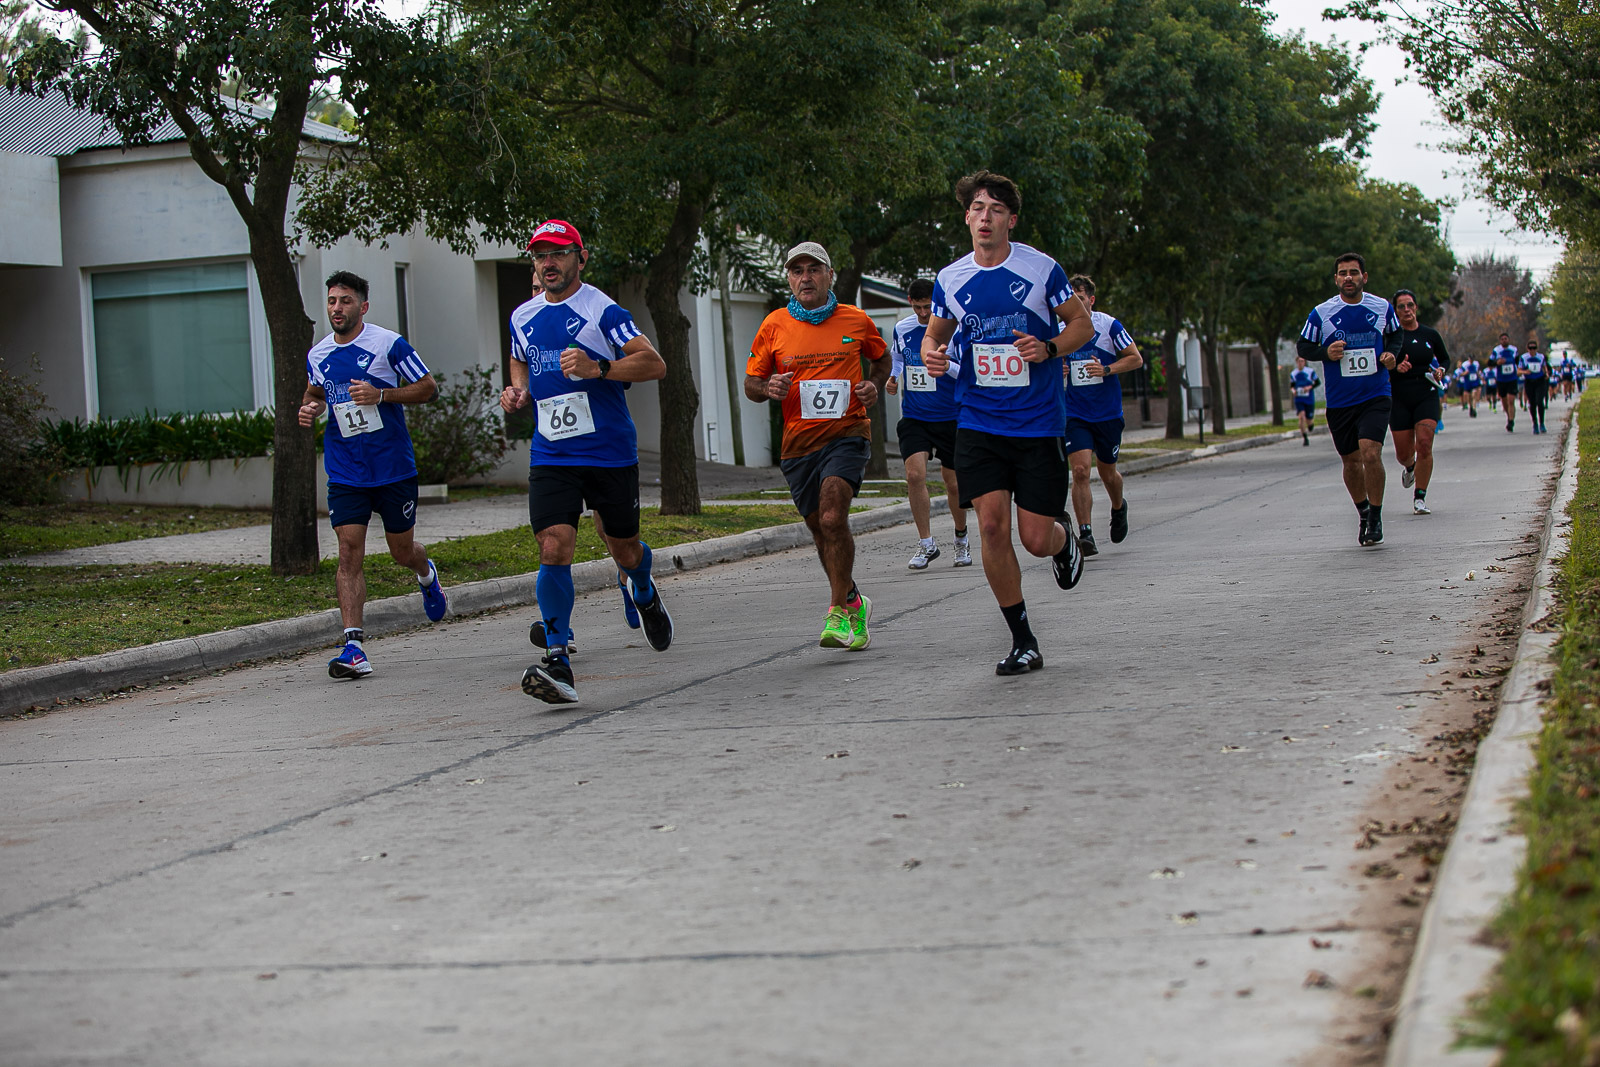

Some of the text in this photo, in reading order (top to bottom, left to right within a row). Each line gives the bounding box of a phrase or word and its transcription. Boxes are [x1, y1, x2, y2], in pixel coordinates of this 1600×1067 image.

[965, 314, 983, 341] 3
[982, 312, 1027, 331] MARATÓN
[528, 345, 542, 376] 3
[978, 356, 1023, 376] 510
[1349, 357, 1368, 370] 10
[912, 374, 927, 385] 51
[324, 380, 337, 405] 3
[813, 391, 839, 409] 67
[345, 409, 369, 428] 11
[550, 406, 577, 430] 66
